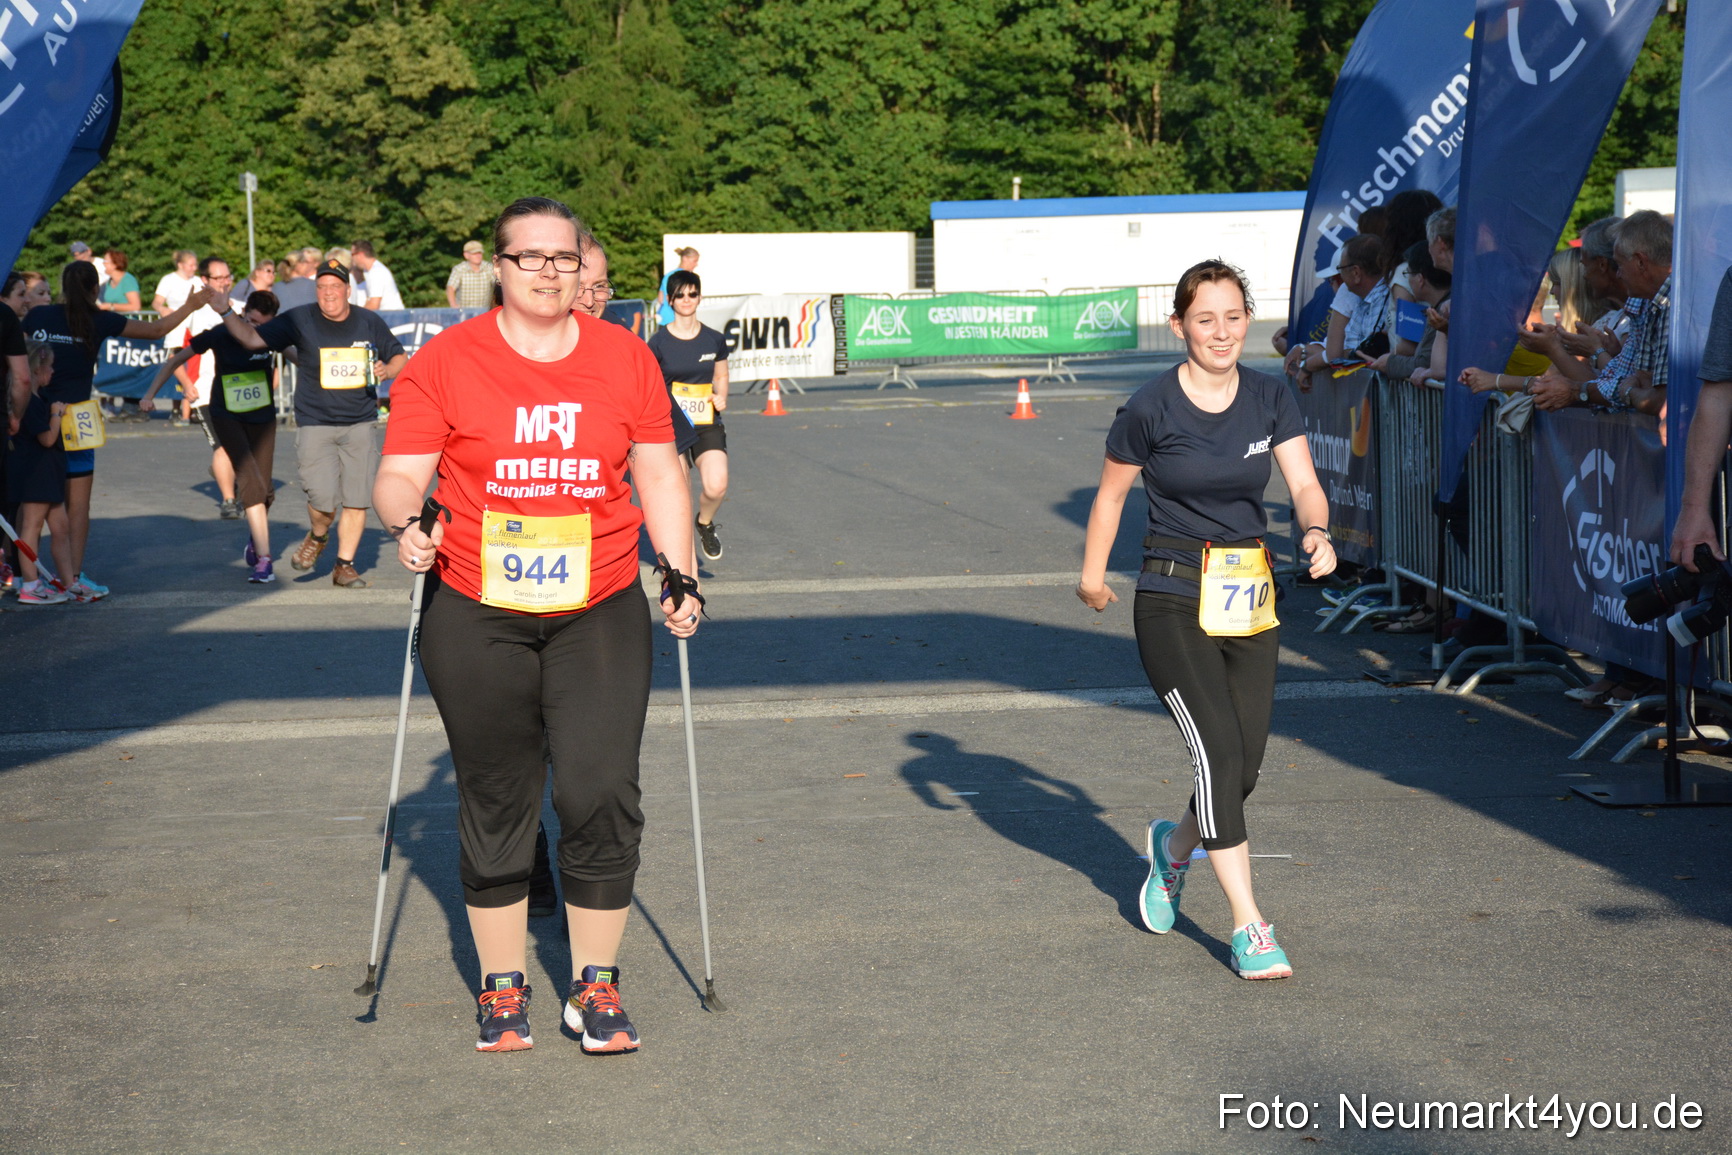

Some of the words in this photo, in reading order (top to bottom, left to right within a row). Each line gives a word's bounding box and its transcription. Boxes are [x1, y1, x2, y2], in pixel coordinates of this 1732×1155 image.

[43, 0, 88, 67] AU
[1438, 119, 1466, 158] Dru
[1317, 62, 1471, 249] Frischman
[857, 304, 912, 337] AOK
[928, 305, 1038, 324] GESUNDHEIT
[1075, 299, 1132, 331] AOK
[723, 316, 791, 353] swn
[990, 323, 1049, 339] HÄNDEN
[330, 365, 358, 377] 682
[233, 387, 261, 402] 766
[680, 399, 705, 413] 680
[76, 411, 94, 441] 728
[515, 402, 582, 450] MRT
[495, 457, 600, 481] MEIER
[486, 480, 556, 499] Running
[560, 482, 606, 499] Team
[1577, 511, 1661, 583] Fischer
[503, 553, 569, 585] 944
[1223, 582, 1269, 612] 710
